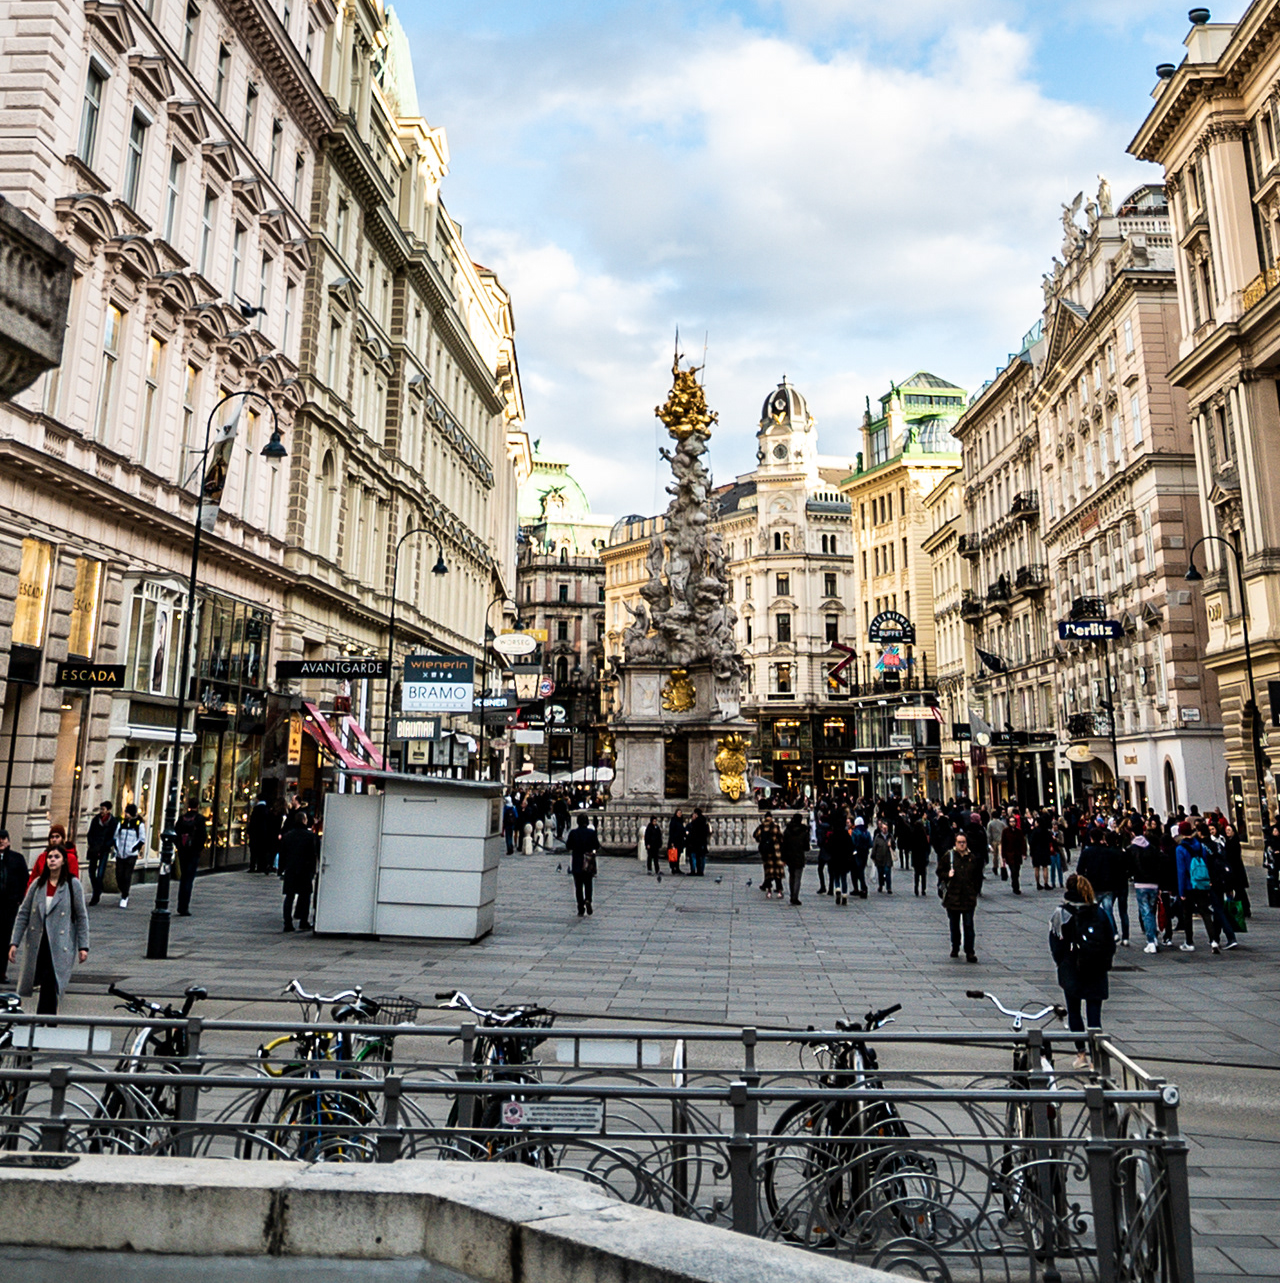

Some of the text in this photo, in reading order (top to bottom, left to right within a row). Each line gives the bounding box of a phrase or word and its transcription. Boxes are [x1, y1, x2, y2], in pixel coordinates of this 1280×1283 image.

[301, 662, 383, 674] AVANTGARDE
[410, 661, 468, 669] wienerin
[62, 669, 117, 682] ESCADA
[408, 686, 467, 700] BRAMO
